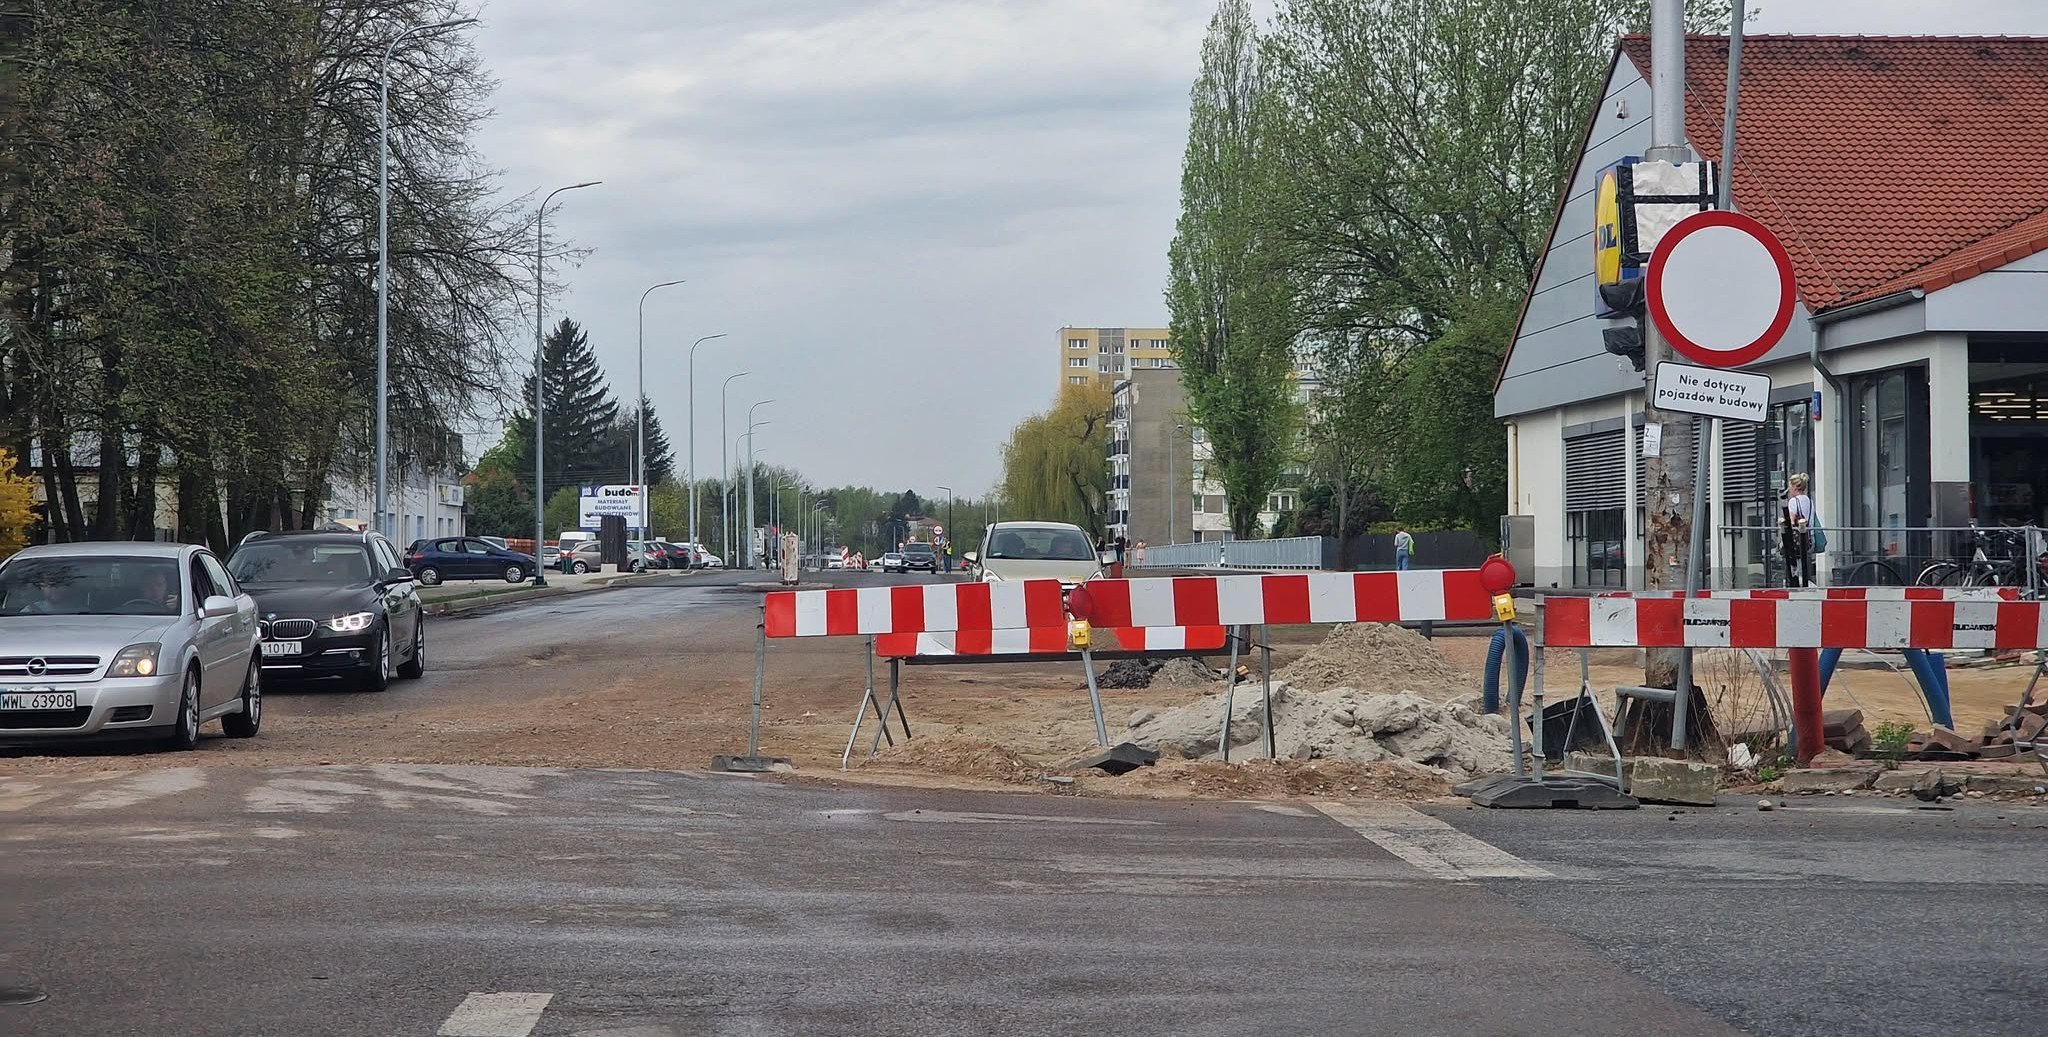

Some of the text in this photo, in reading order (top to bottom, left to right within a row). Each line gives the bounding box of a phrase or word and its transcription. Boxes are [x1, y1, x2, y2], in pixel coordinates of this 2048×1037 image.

[1679, 375, 1746, 395] Nie dotyczy
[1659, 388, 1763, 412] pojazdów budowy
[268, 643, 300, 654] 1017L
[2, 694, 73, 709] WWL 63908
